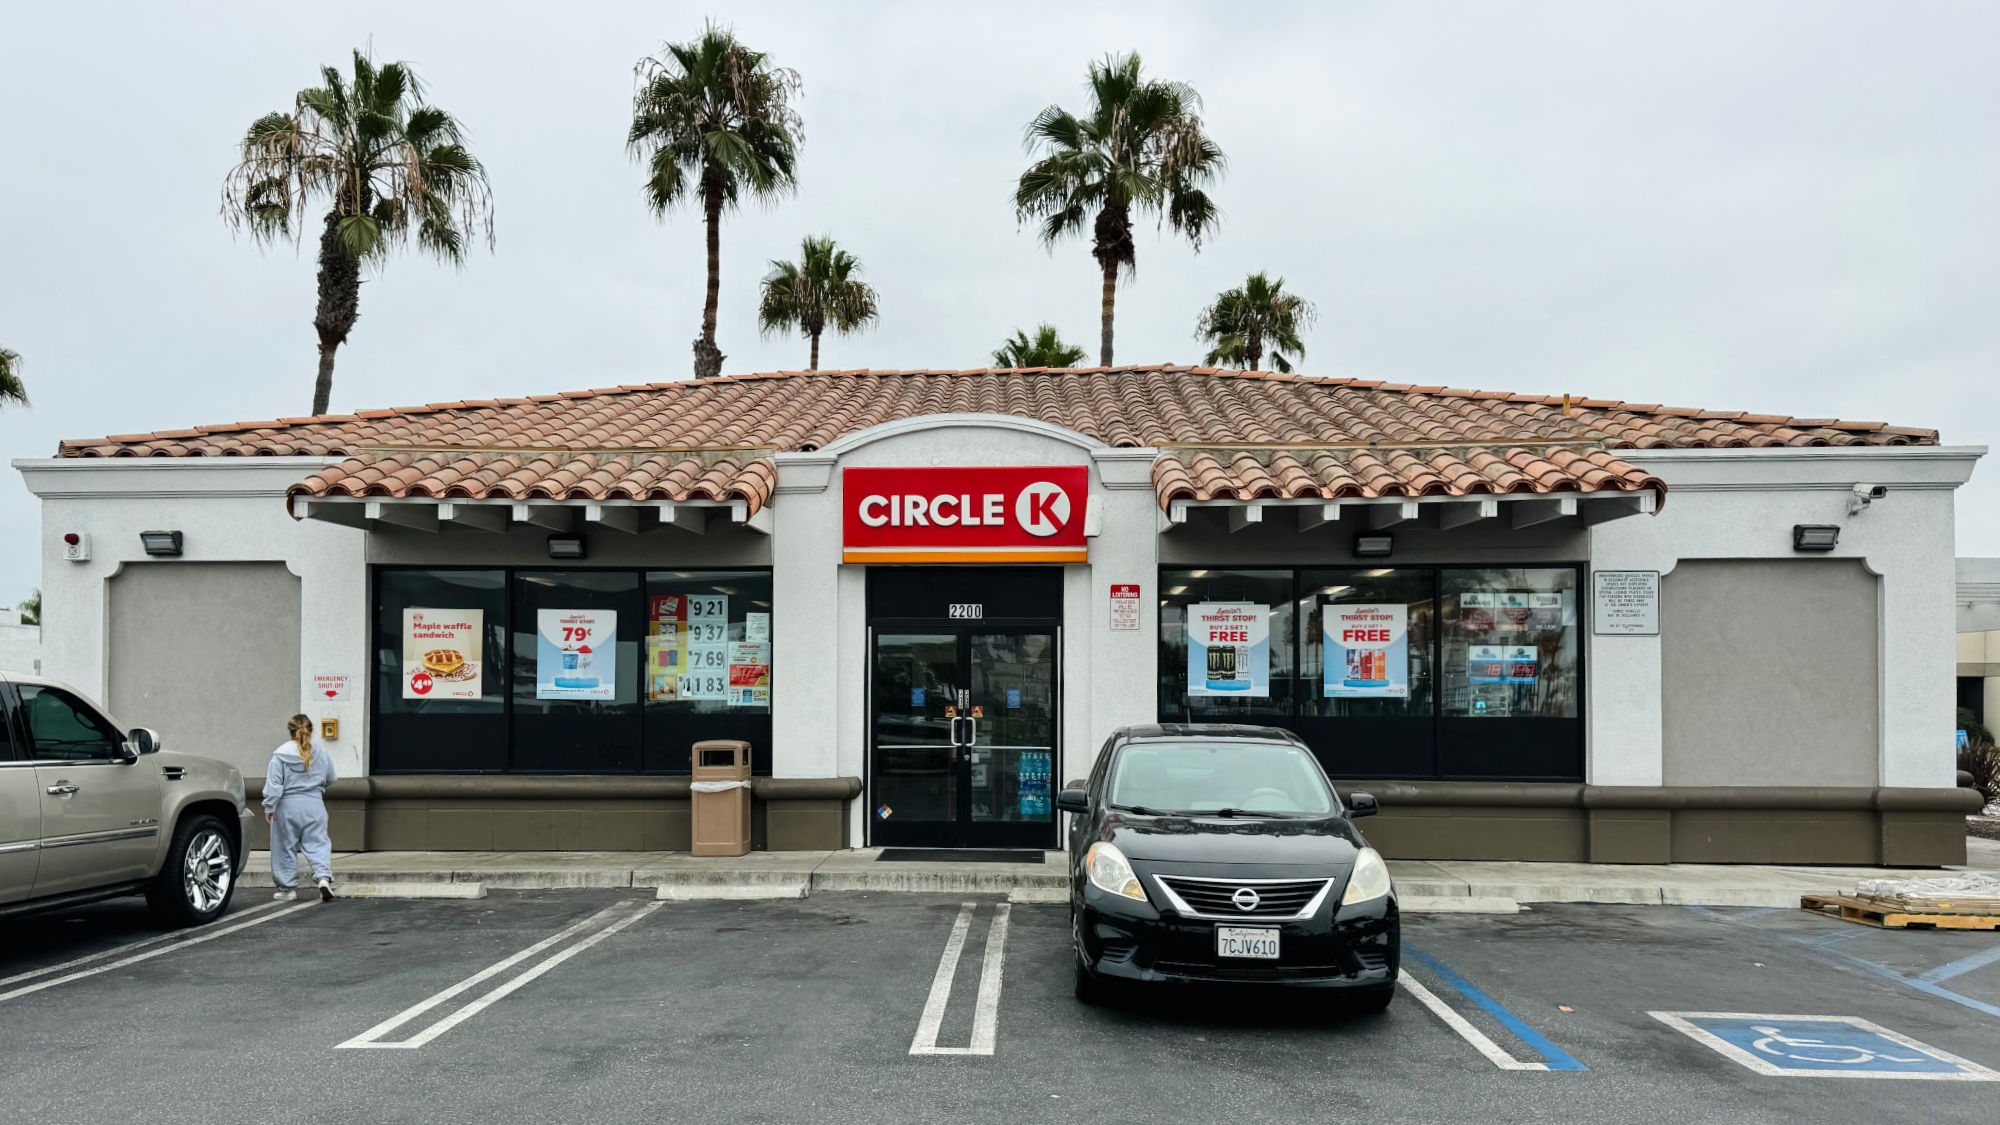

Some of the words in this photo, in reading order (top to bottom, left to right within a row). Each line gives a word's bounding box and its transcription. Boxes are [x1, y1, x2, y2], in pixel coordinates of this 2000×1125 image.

[859, 494, 1005, 528] CIRCLE
[1028, 490, 1067, 534] K
[950, 605, 982, 618] 2200
[413, 623, 441, 631] Maple
[443, 622, 472, 630] waffle
[562, 627, 592, 641] 79¢
[1209, 631, 1248, 642] FREE
[1343, 629, 1390, 642] FREE
[1221, 938, 1276, 954] 7CJV610
